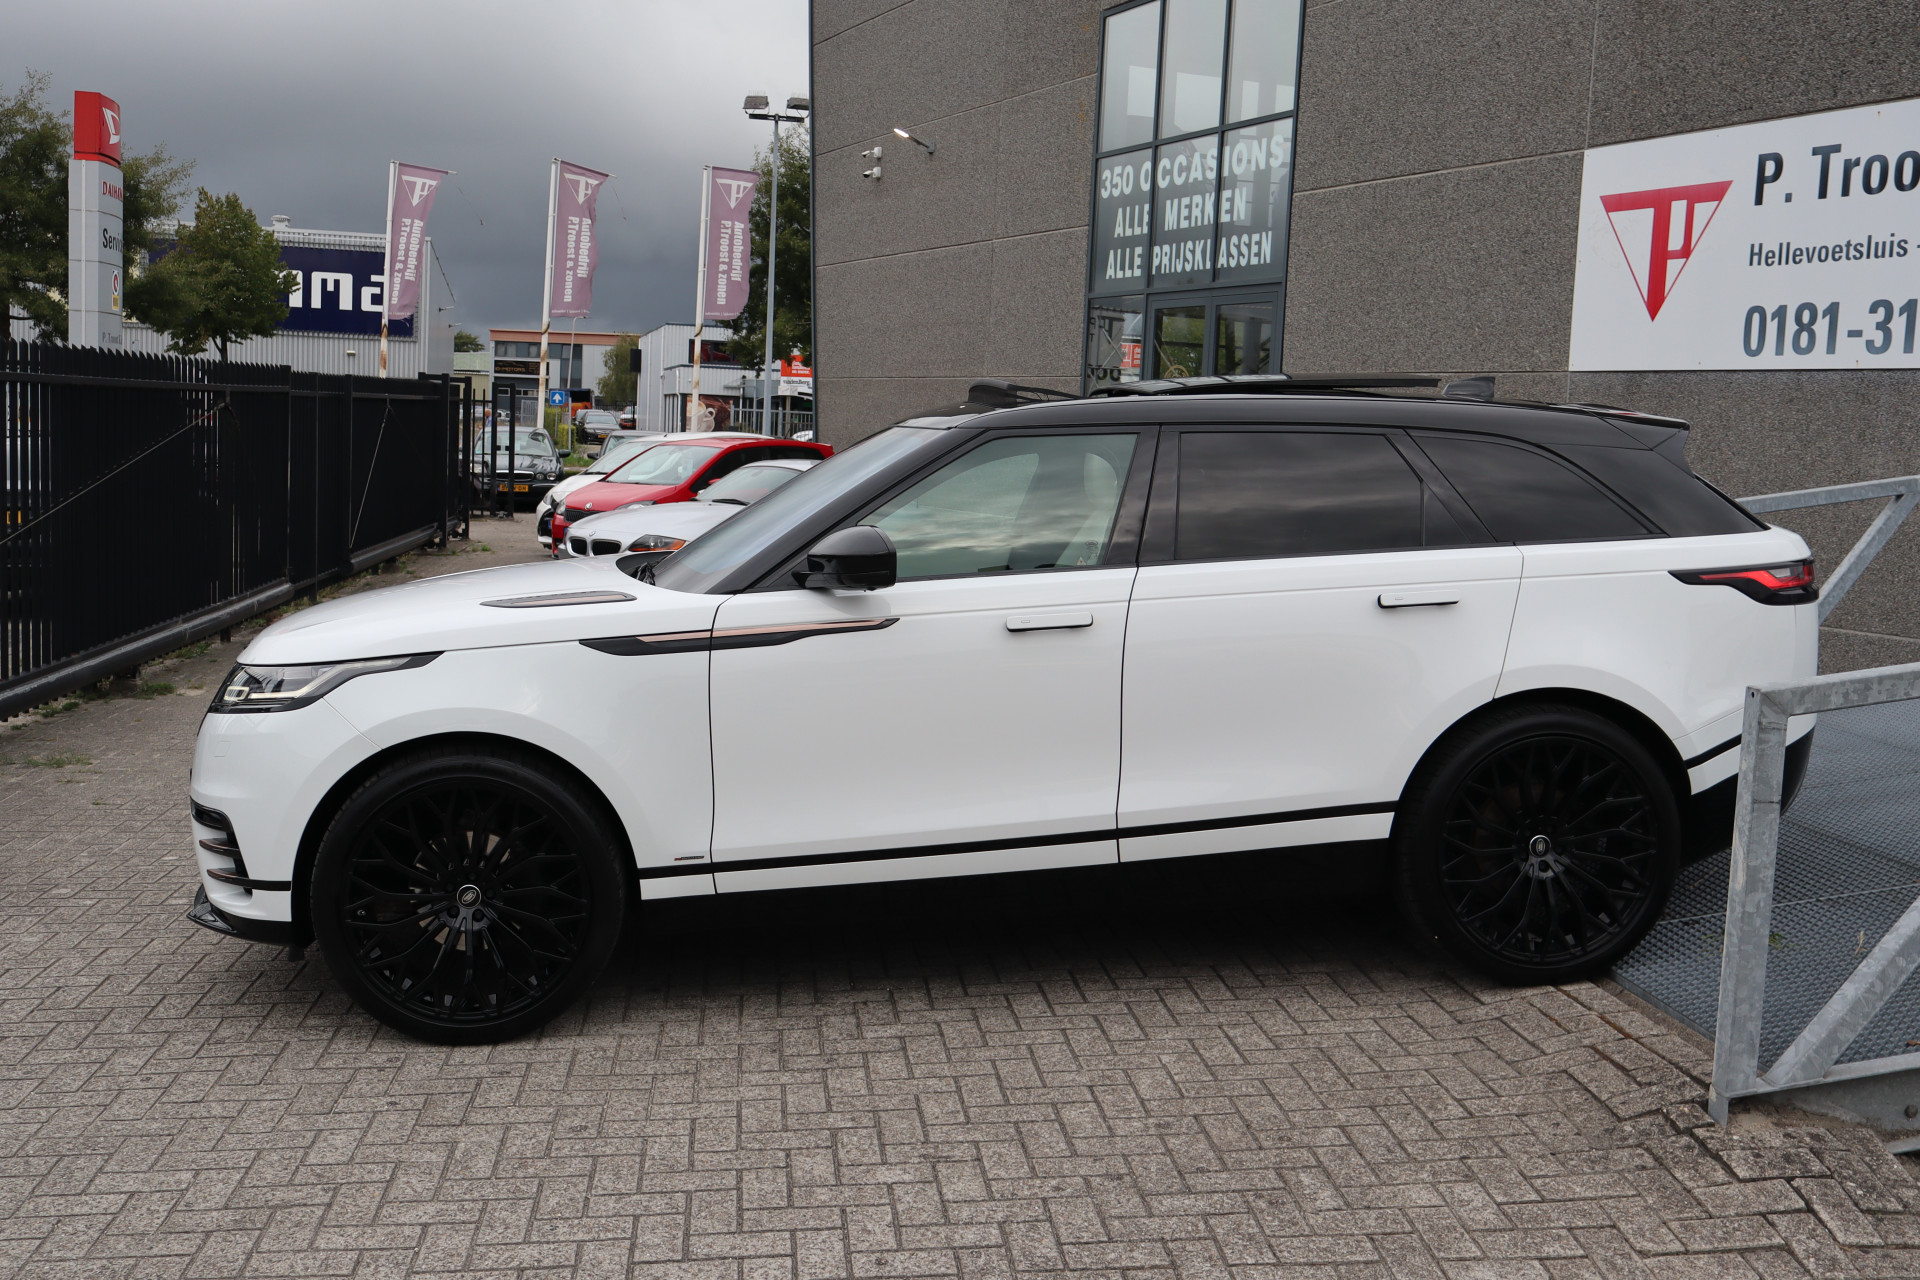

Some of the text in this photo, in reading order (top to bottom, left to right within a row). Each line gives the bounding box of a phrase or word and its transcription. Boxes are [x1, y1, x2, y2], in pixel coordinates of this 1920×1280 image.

[1101, 134, 1285, 199] 350 OCCASIONS
[1754, 143, 1920, 206] P. Troo
[1114, 187, 1247, 238] ALLE MERKEN
[405, 219, 424, 282] Autobedrijf
[577, 218, 592, 278] Autobedrijf
[731, 221, 745, 282] Autobedrijf
[1106, 231, 1272, 279] ALLE PRIJSKLASSEN
[1748, 232, 1909, 267] Hellevoetsluis
[1742, 298, 1918, 358] 0181-31
